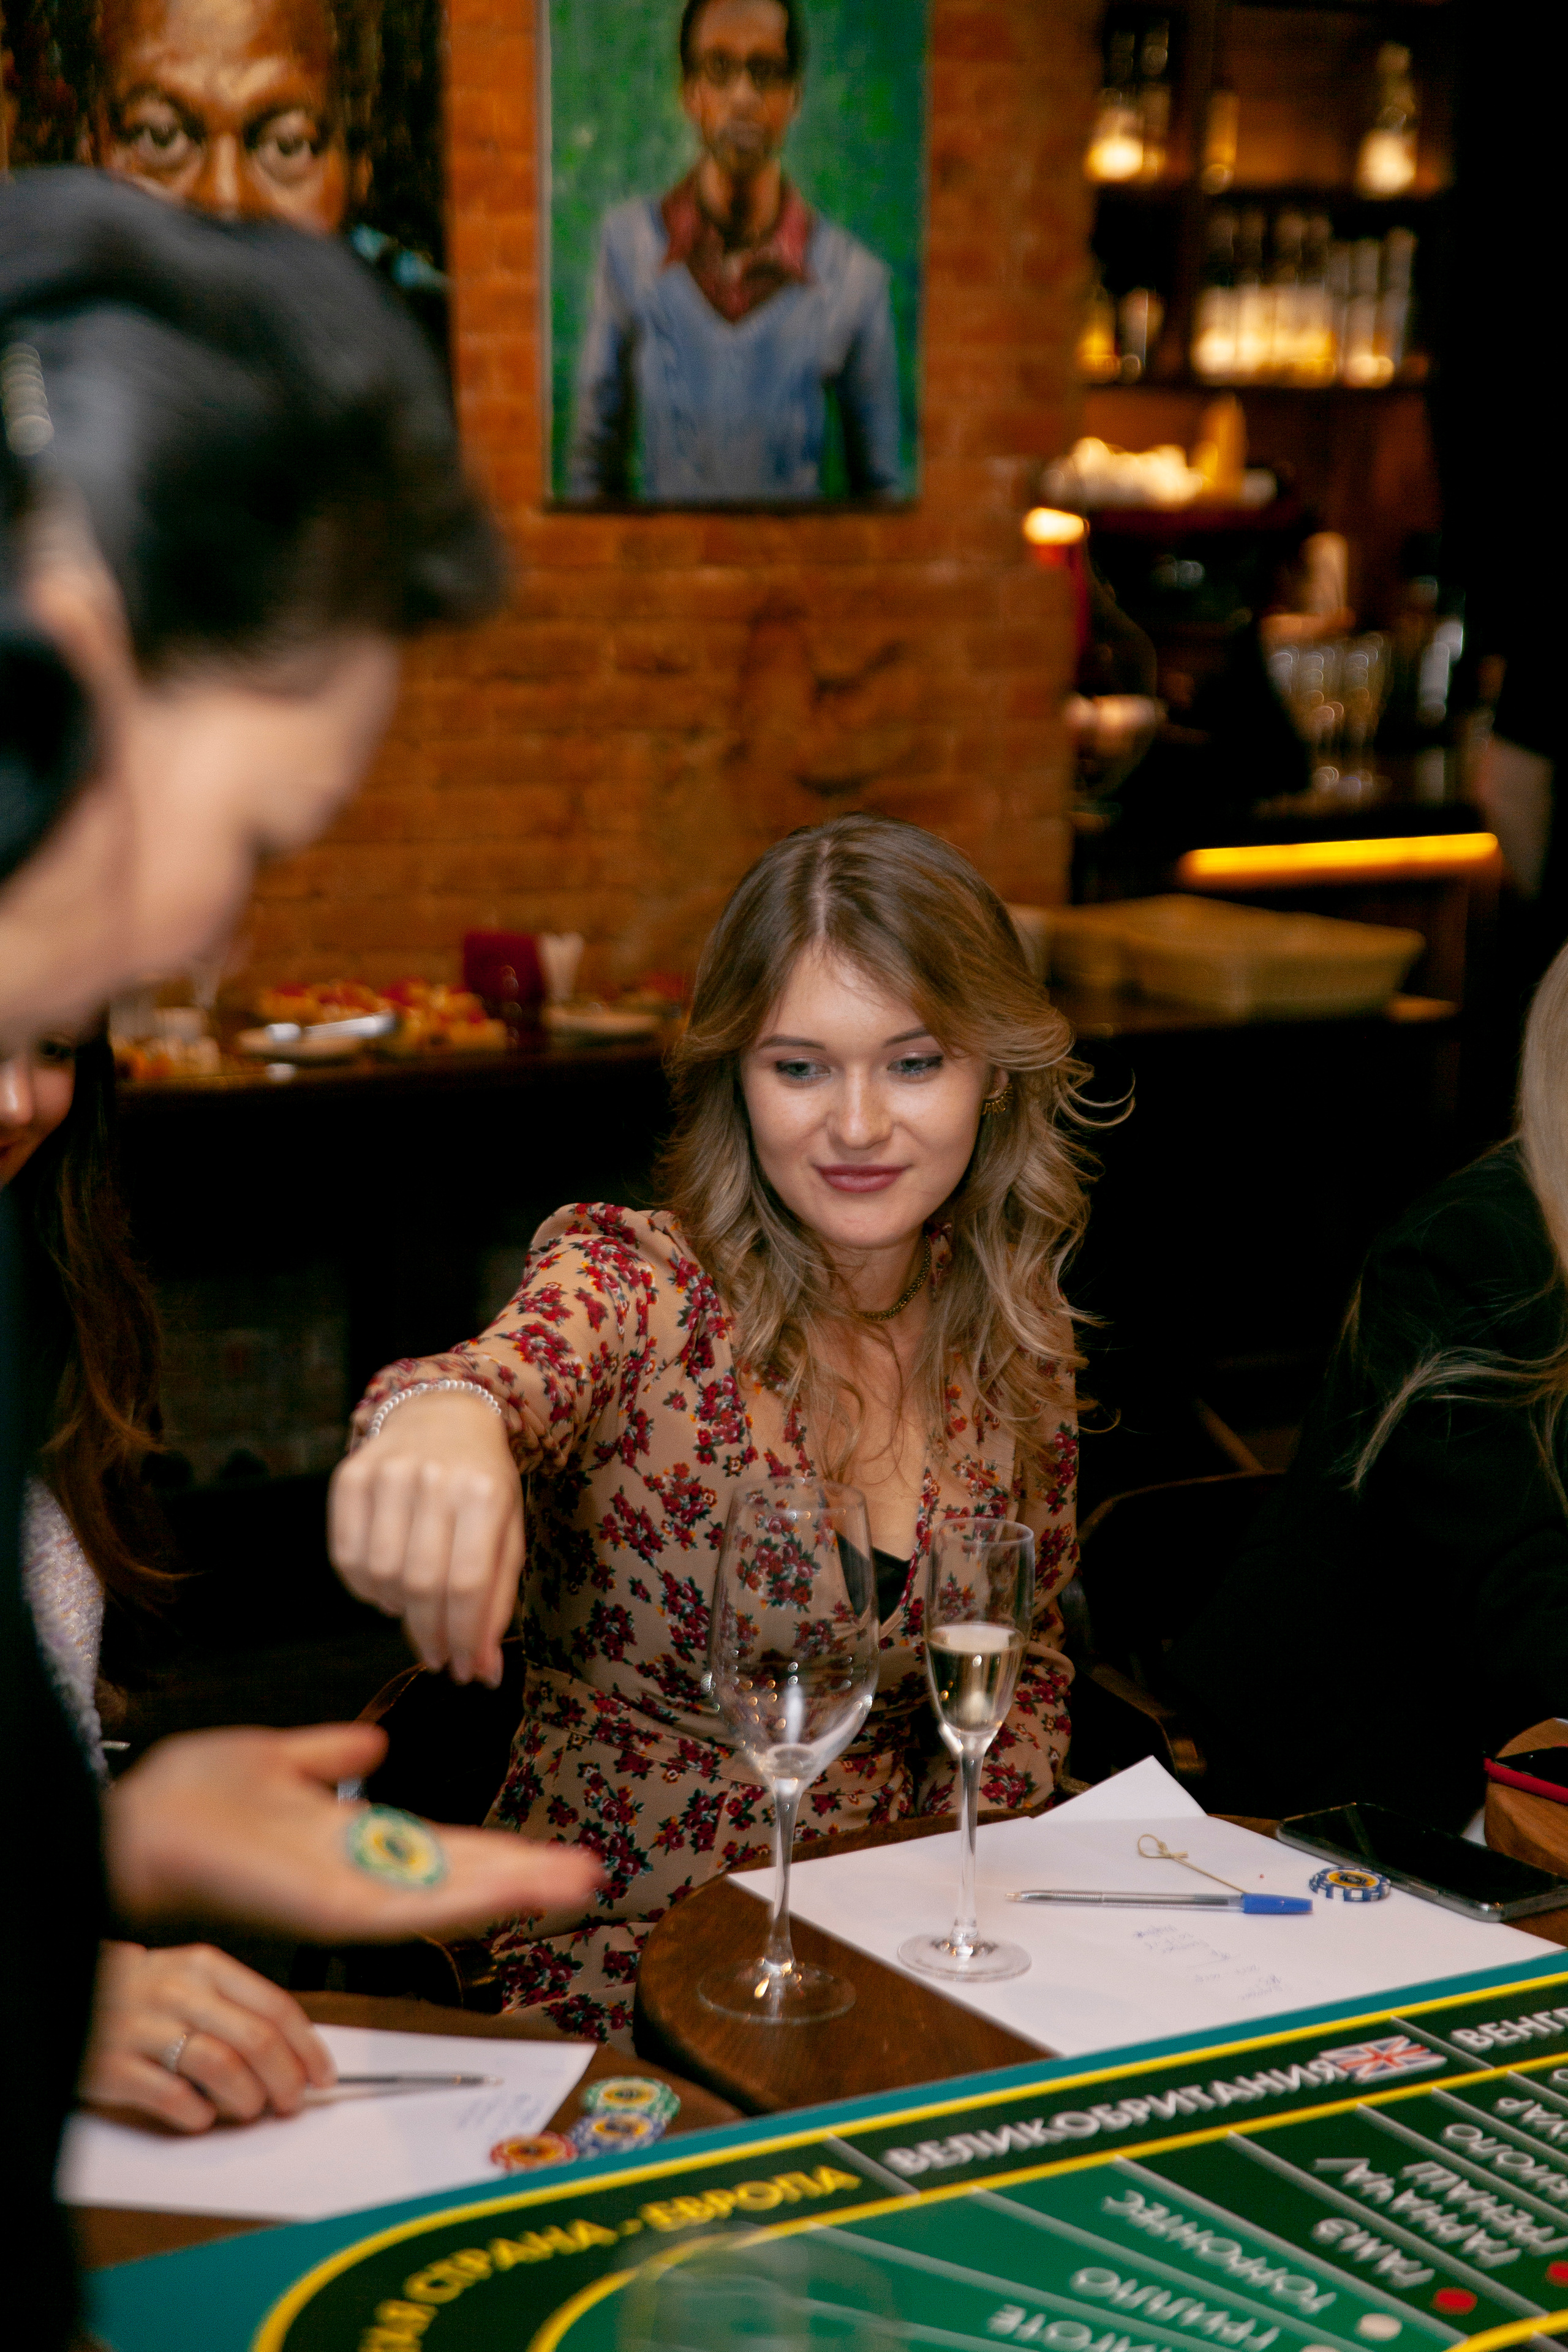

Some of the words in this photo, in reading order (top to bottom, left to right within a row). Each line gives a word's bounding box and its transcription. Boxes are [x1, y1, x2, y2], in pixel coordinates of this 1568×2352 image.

[884, 2057, 1348, 2177] ВЕЛИКОБРИТАНИЯ
[401, 2218, 619, 2305] СТРАНА
[639, 2164, 862, 2233] ЕВРОПА
[1313, 2218, 1436, 2289] ГАМЭ
